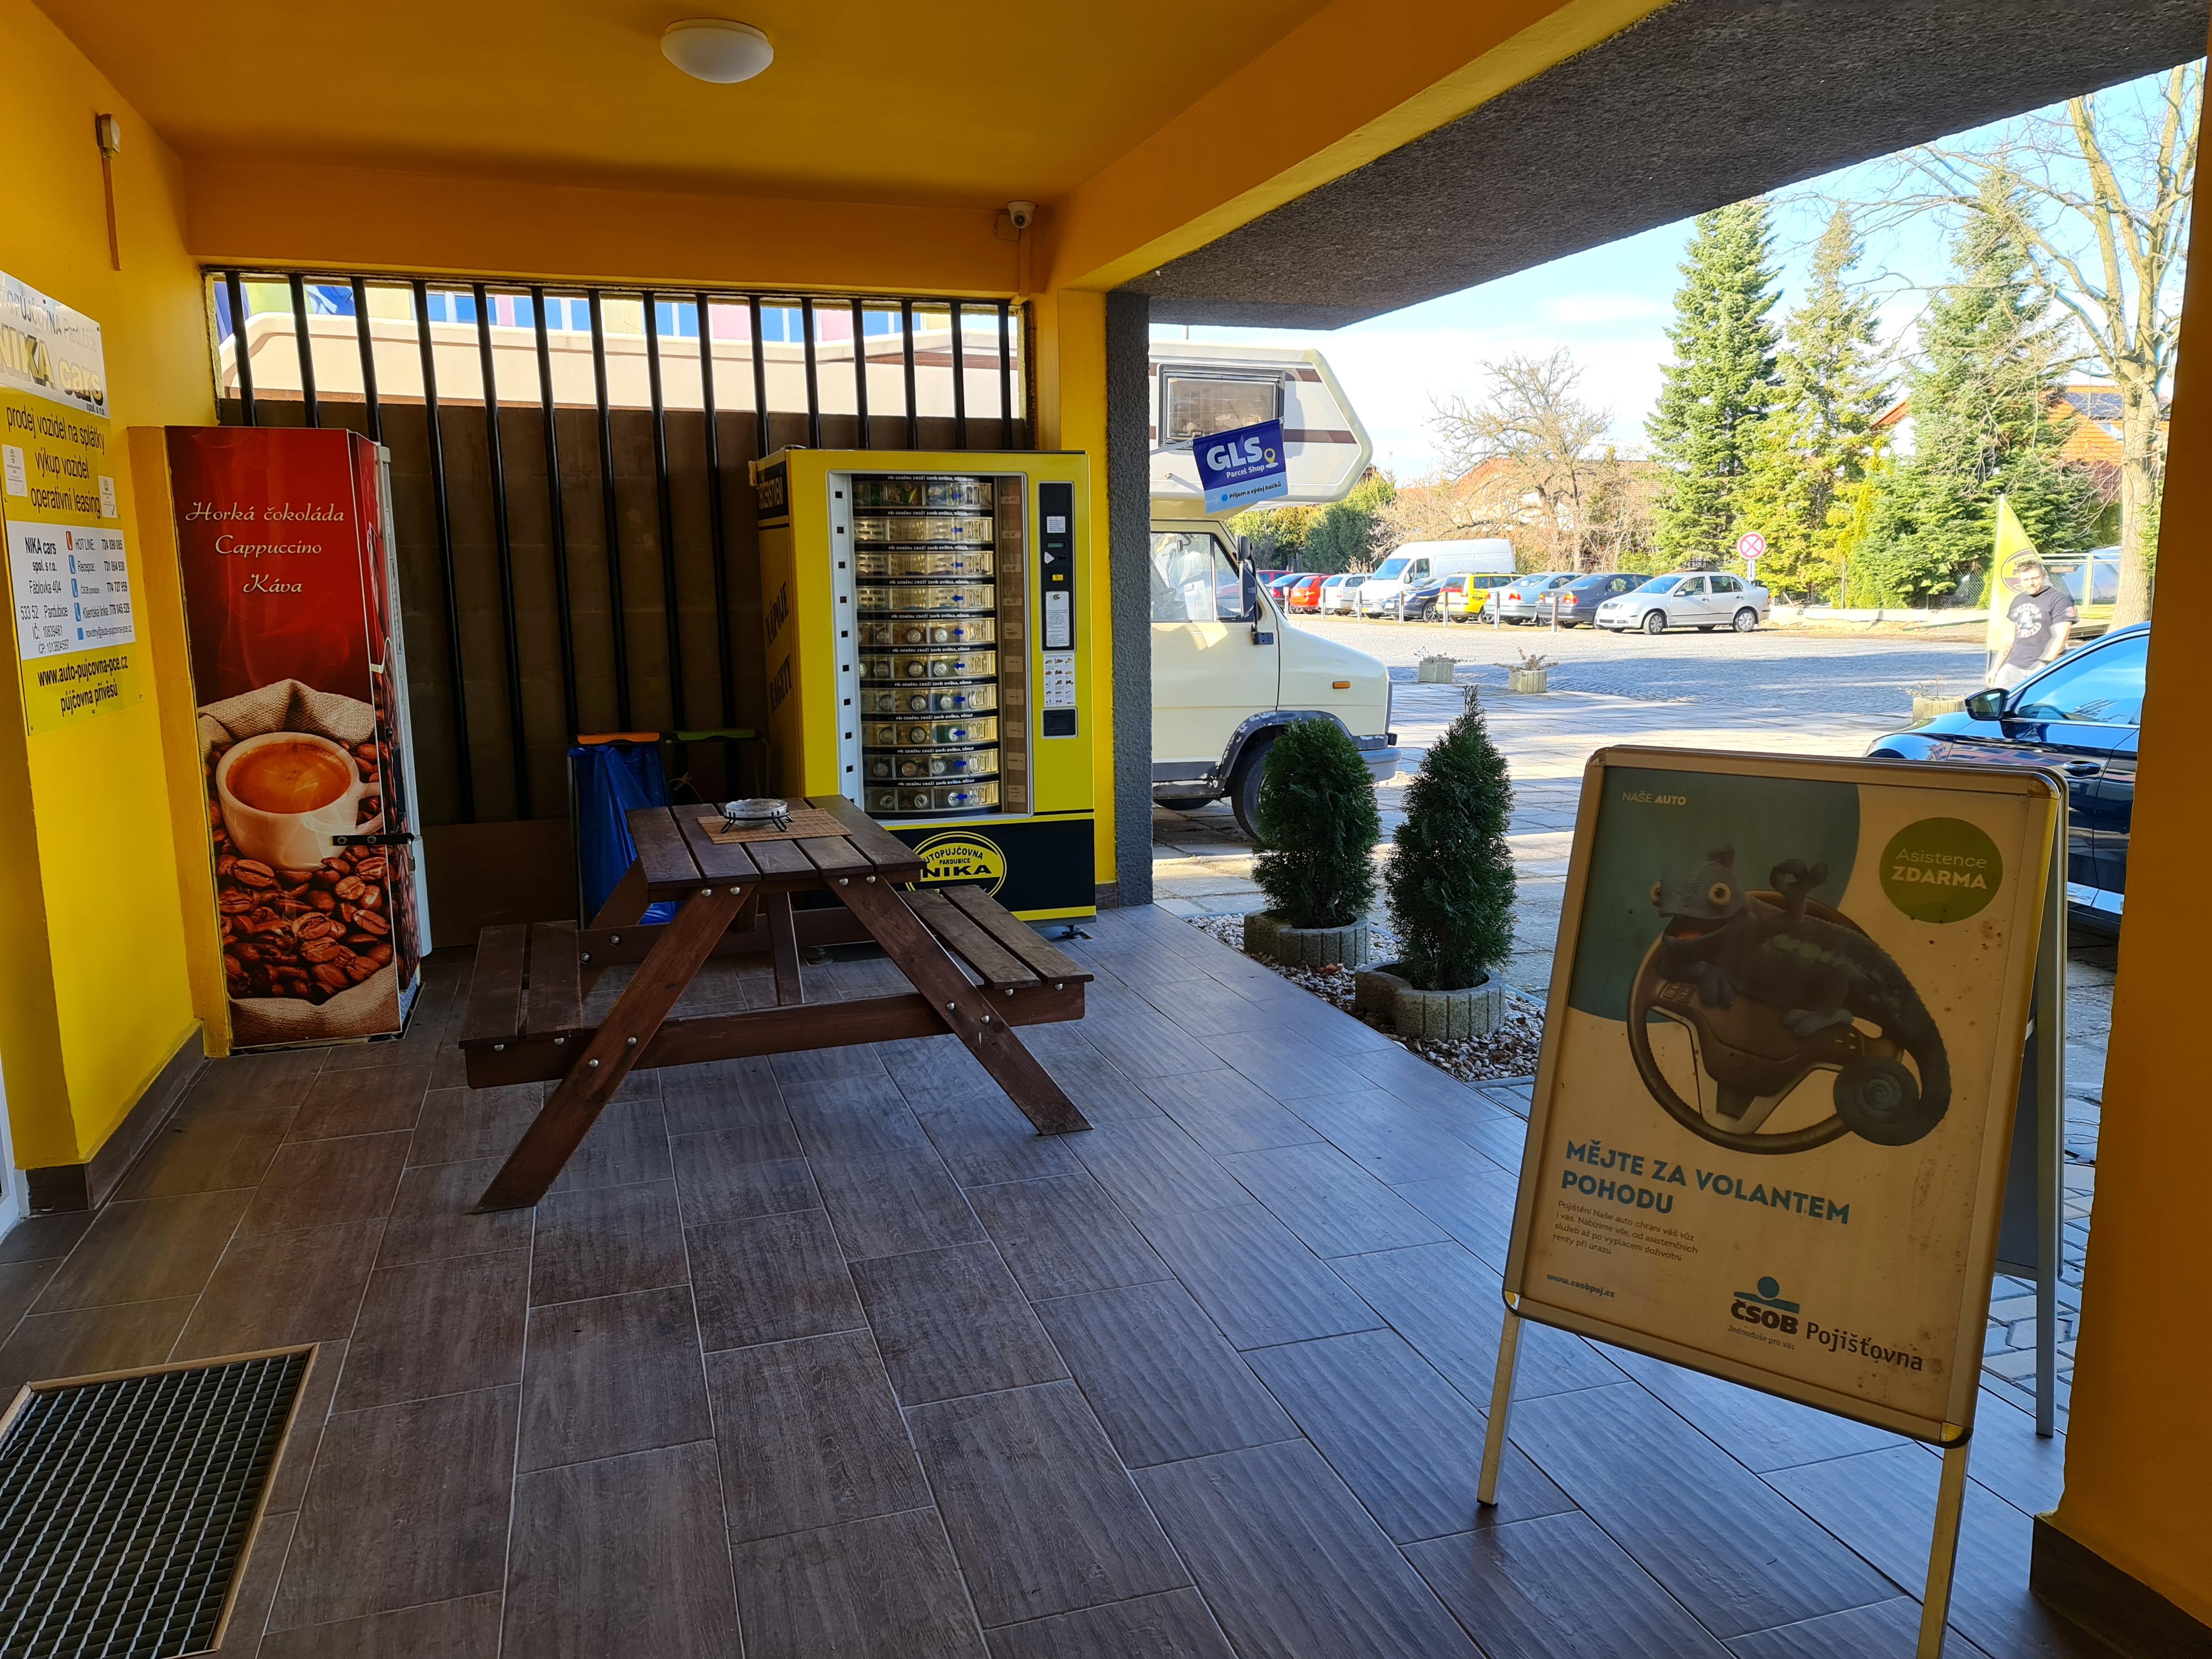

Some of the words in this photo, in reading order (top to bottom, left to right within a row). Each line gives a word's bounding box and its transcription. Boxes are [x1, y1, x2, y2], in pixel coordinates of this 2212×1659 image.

[58, 357, 104, 406] cars
[7, 404, 35, 439] prodej
[36, 413, 66, 440] vozidel
[68, 424, 78, 442] na
[79, 424, 105, 455] splátky
[35, 446, 60, 479] výkup
[61, 454, 89, 479] vozidel
[1207, 436, 1262, 471] GLS
[1226, 468, 1247, 478] Parcel
[1248, 465, 1265, 474] Shop
[1251, 484, 1265, 495] výdej
[1265, 481, 1281, 491] balíků
[73, 488, 101, 519] leasing
[185, 501, 255, 521] Horká
[263, 502, 345, 521] čokoláda
[25, 536, 42, 554] NIKA
[43, 542, 56, 555] cars
[215, 534, 322, 559] Cappuccino
[32, 559, 44, 574] spol.
[29, 580, 51, 594] Fáblovka
[53, 580, 61, 593] 404
[243, 573, 302, 593] Káva
[20, 606, 31, 620] 533
[32, 605, 39, 619] 52
[44, 604, 67, 618] Pardubice
[38, 655, 128, 687] www.auto-pujcovna-pce.cz
[60, 689, 93, 717] půjčovna
[94, 677, 118, 707] přívěsů
[1622, 790, 1653, 803] NAŠE
[1655, 795, 1687, 806] AUTO
[924, 846, 983, 864] UTOPUJČOVNA
[1895, 848, 1987, 869] Asistence
[922, 864, 992, 878] NIKA
[1891, 865, 1987, 890] ZDARMA
[1561, 1170, 1674, 1214] POHODU
[1566, 1139, 1645, 1176] MĚJTE
[1651, 1160, 1687, 1187] ZA
[1695, 1168, 1850, 1224] VOLANTEM
[1558, 1200, 1592, 1215] Pojištění
[1593, 1209, 1614, 1220] Naše
[1615, 1217, 1633, 1226] auto
[1635, 1221, 1661, 1233] chrání
[1663, 1228, 1678, 1237] váš
[1681, 1232, 1694, 1241] vůz
[1553, 1234, 1574, 1245] renty
[1589, 1242, 1614, 1255] úrazu.
[1554, 1223, 1579, 1234] služeb
[1604, 1237, 1642, 1251] vyplácení
[1645, 1246, 1682, 1261] doživotní
[1561, 1213, 1575, 1222] vás.
[1578, 1217, 1614, 1232] Nabízíme
[1645, 1235, 1698, 1254] asistenčních
[1547, 1274, 1615, 1298] www.csobpoj.cz
[1728, 1324, 1767, 1342] Jednoduše
[1782, 1342, 1795, 1350] vás
[1731, 1300, 1798, 1334] ČSOB
[1806, 1321, 1923, 1371] Pojišťovna
